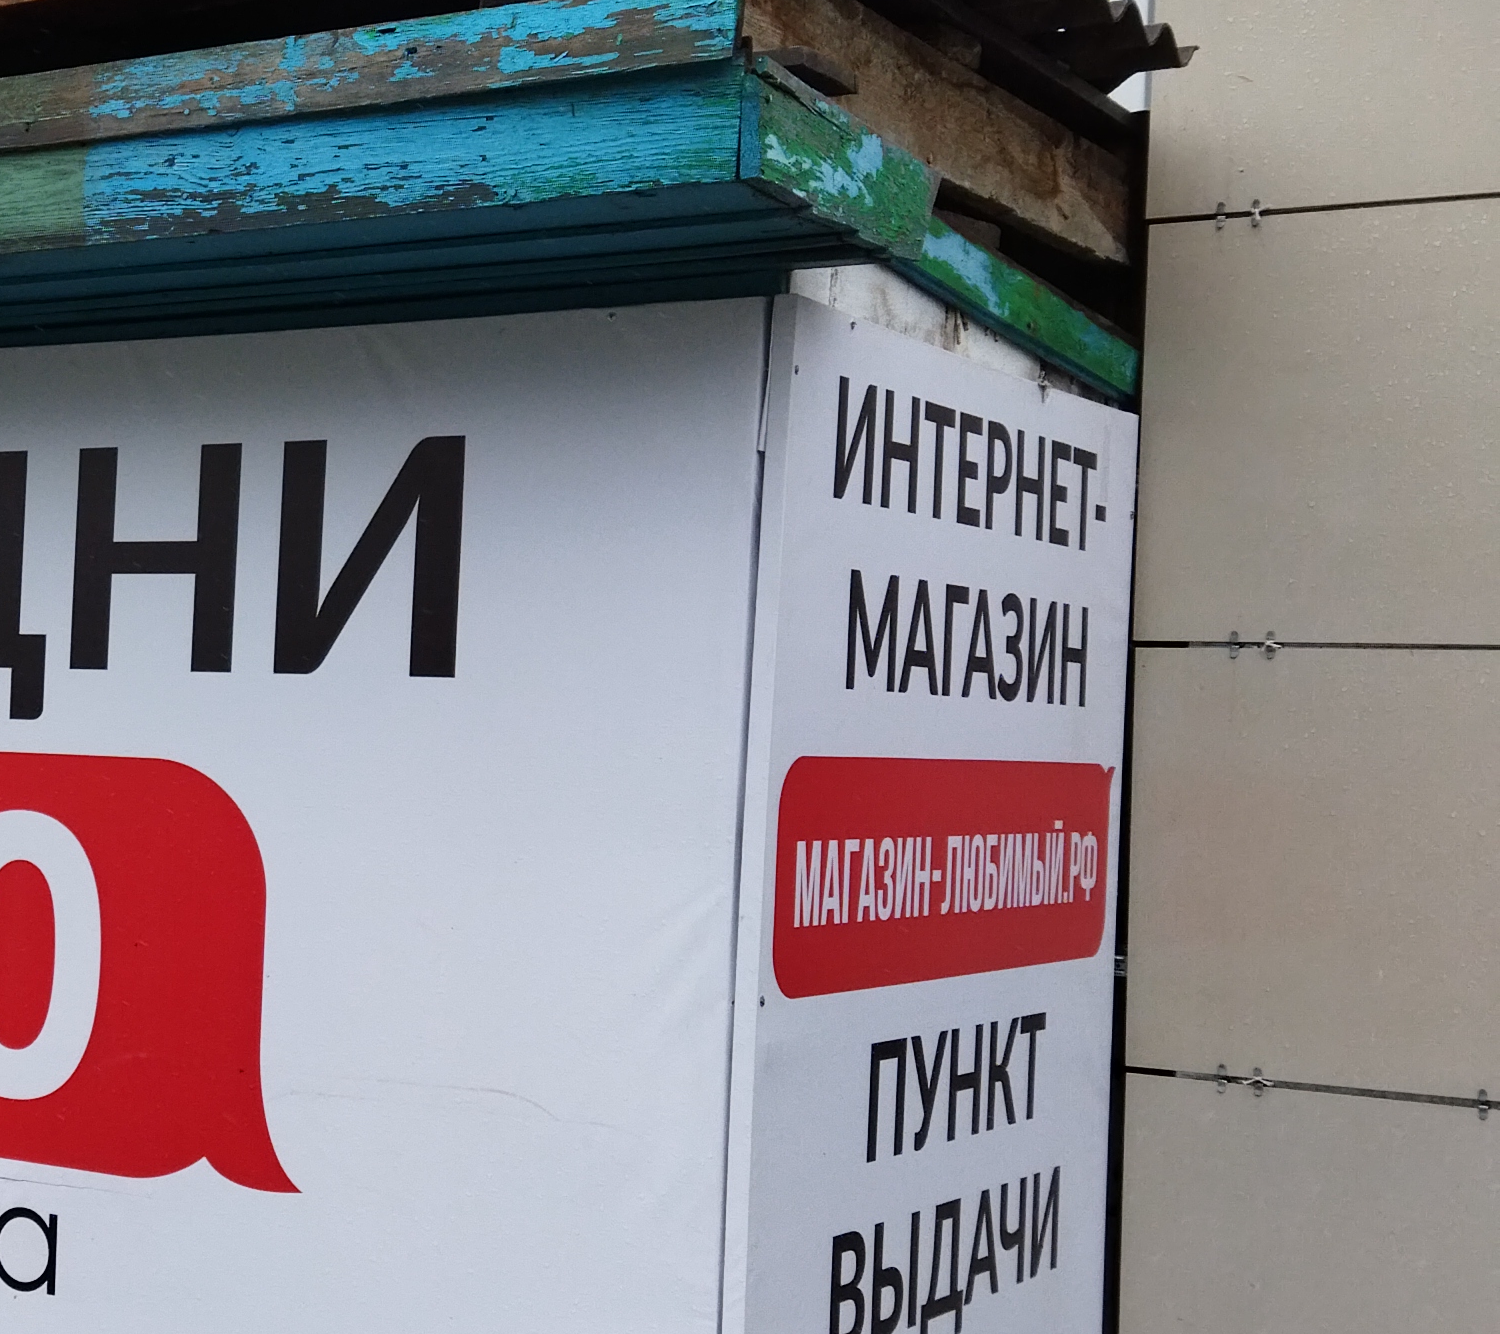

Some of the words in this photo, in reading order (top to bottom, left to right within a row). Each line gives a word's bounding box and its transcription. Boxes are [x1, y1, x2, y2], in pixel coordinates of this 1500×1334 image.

[833, 375, 1107, 552] ИНТЕРНЕТ-
[845, 568, 1090, 708] МАГАЗИН
[792, 819, 1099, 929] МАГАЗИН-ЛЮБИМЫЙ.РФ
[866, 1011, 1048, 1164] ПУНКТ
